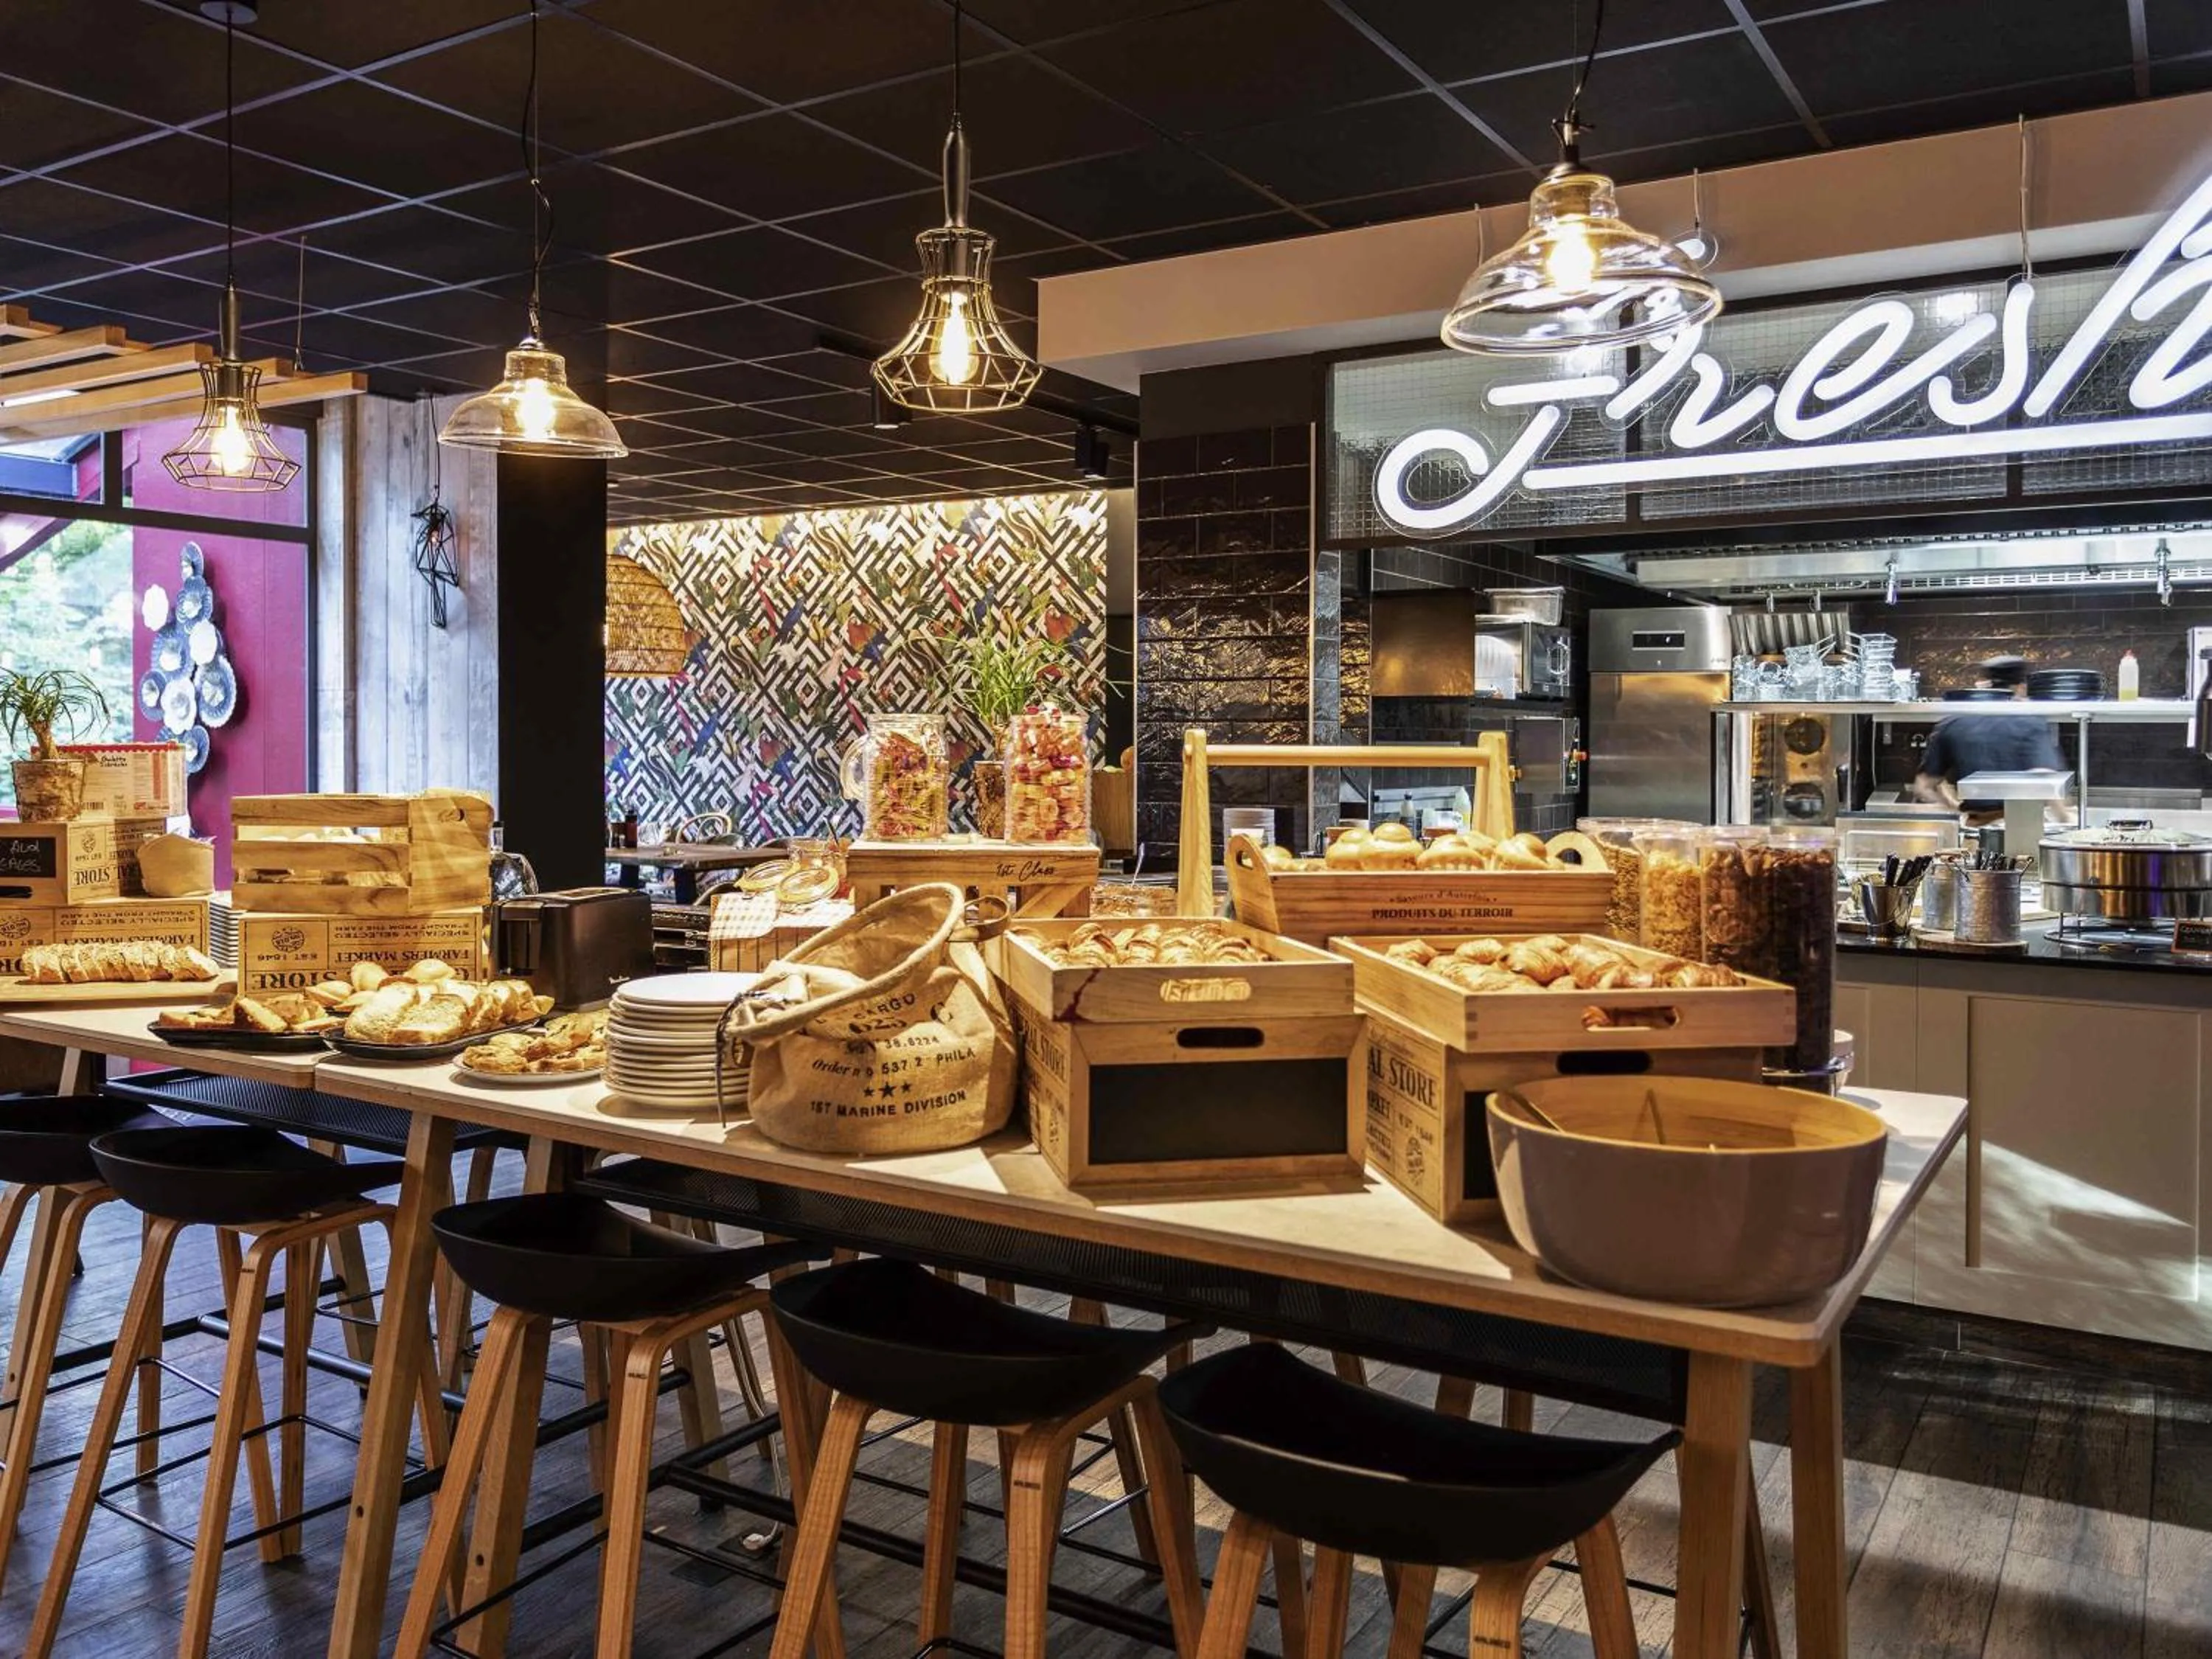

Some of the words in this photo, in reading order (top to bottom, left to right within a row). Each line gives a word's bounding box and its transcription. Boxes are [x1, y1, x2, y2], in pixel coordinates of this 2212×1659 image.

[74, 866, 110, 886] STORE
[1371, 907, 1437, 919] PRODUITS
[1439, 907, 1455, 918] DU
[1460, 907, 1514, 918] TERROIR
[335, 951, 397, 963] MARKET
[401, 950, 468, 961] FARMERS
[251, 971, 337, 990] STORE
[853, 992, 916, 1019] CARGO
[936, 1047, 977, 1066] PHILA
[1388, 1057, 1438, 1111] STORE
[836, 1104, 897, 1118] MARINE
[903, 1089, 967, 1115] DIVISION
